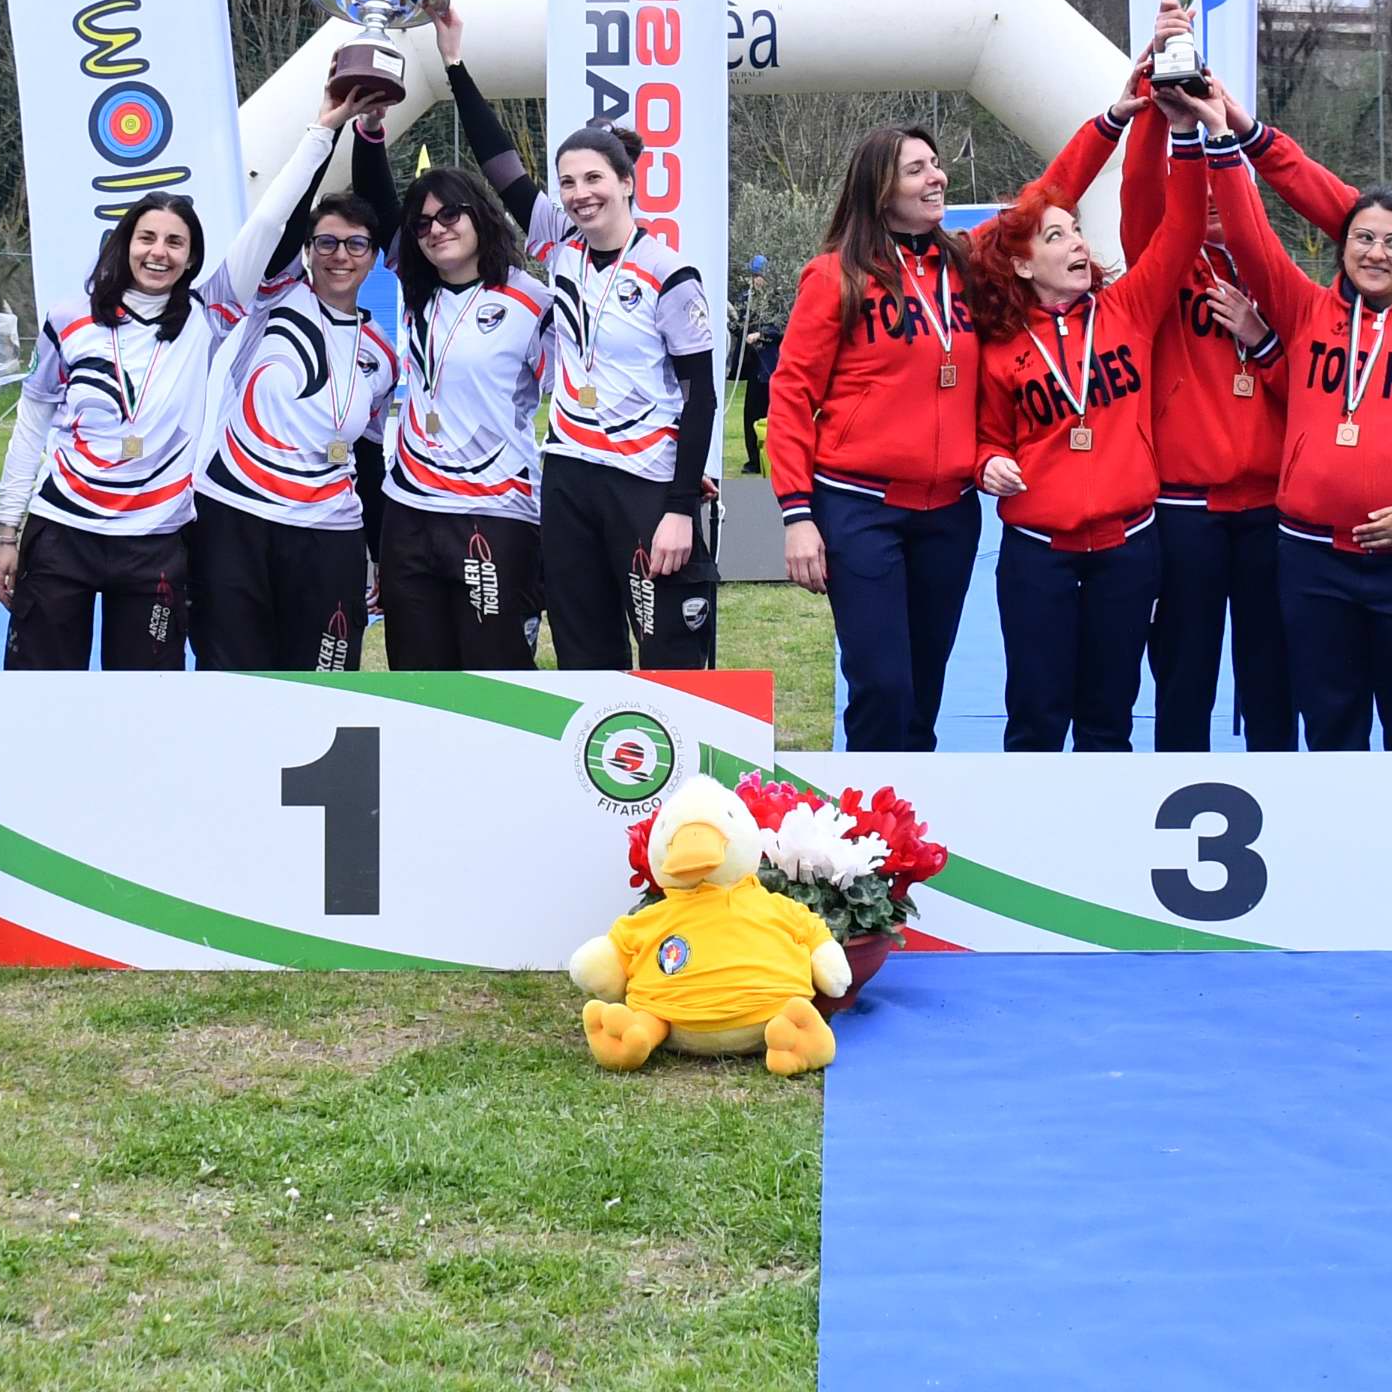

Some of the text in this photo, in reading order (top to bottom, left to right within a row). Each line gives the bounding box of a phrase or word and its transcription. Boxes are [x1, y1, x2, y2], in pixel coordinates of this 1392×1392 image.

[464, 559, 482, 610] ARCIERI
[481, 562, 499, 615] TIGULLIO
[628, 572, 644, 626] ARCIERI
[641, 579, 655, 635] TIGULLIO
[316, 632, 336, 671] RCIERI
[332, 639, 348, 671] ULLIO
[280, 726, 381, 915] 1
[597, 797, 662, 816] FITARCO
[1150, 782, 1268, 921] 3
